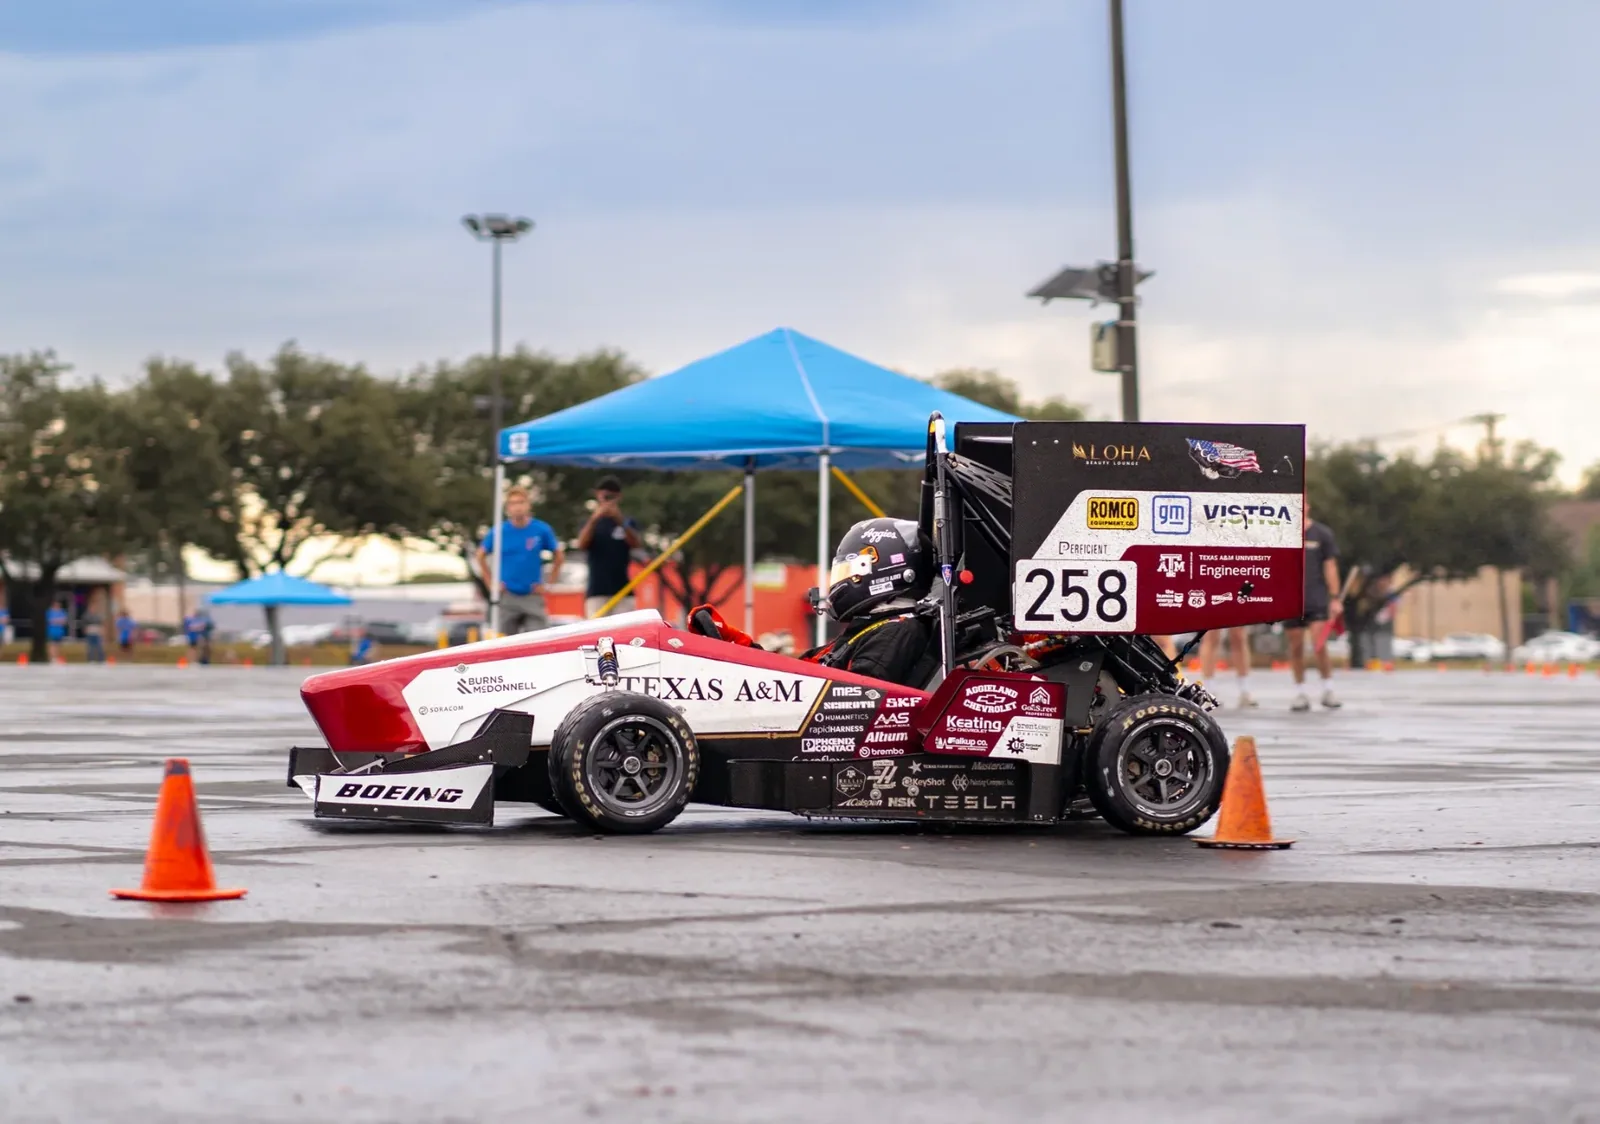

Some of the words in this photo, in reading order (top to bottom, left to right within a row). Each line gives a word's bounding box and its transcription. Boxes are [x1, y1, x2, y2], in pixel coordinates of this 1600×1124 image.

[1090, 501, 1135, 519] ROMCO
[1159, 505, 1184, 525] gm
[1203, 504, 1292, 526] VISTRA
[861, 528, 897, 543] Aggies
[1200, 564, 1271, 579] Engineering
[1025, 568, 1128, 623] 258
[1192, 598, 1202, 606] 66
[468, 676, 504, 686] BURNS
[619, 677, 724, 700] TEXAS
[735, 679, 803, 702] A&M
[965, 684, 1018, 699] AGGIELAND
[429, 705, 464, 713] SORACOM
[886, 697, 922, 708] SKF
[963, 699, 1017, 713] CHEVROLET
[874, 712, 910, 725] AAS
[809, 725, 864, 735] rapidHARNESS
[864, 731, 908, 743] Altium
[871, 748, 904, 756] brembo
[913, 778, 946, 787] KeyShot
[335, 783, 464, 802] BOEING
[887, 797, 917, 808] NSK
[924, 796, 1015, 809] TESLA
